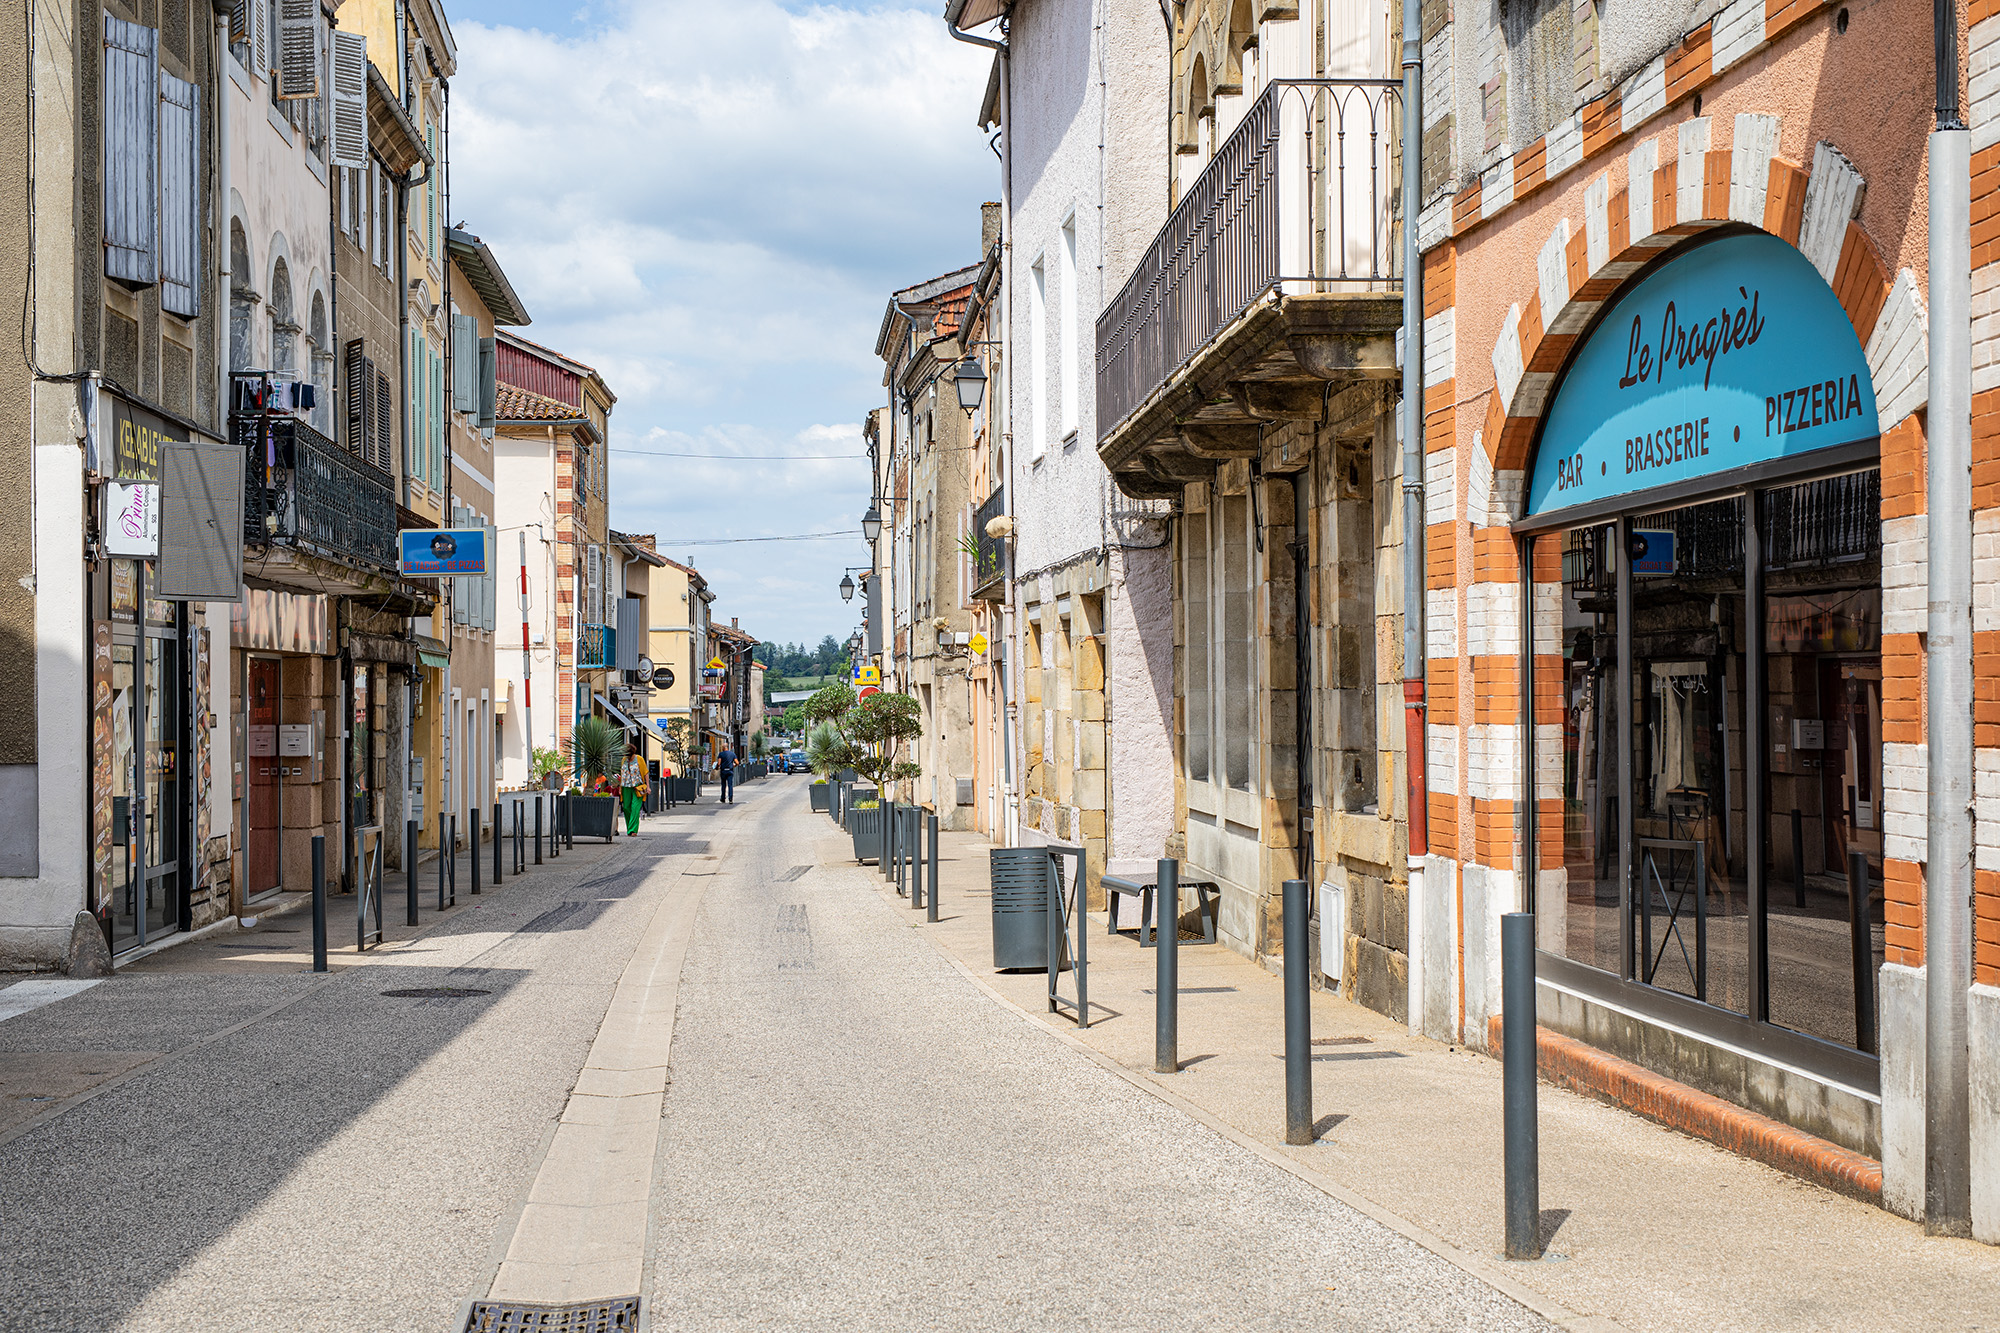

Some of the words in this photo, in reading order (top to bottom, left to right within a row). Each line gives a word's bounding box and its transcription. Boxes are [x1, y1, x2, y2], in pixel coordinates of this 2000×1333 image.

[1618, 313, 1654, 390] Le
[1656, 286, 1766, 391] Progrès
[1557, 452, 1584, 492] BAR
[1625, 416, 1710, 475] BRASSERIE
[1764, 373, 1863, 438] PIZZERIA
[120, 484, 143, 539] Prime
[403, 561, 413, 571] BE
[415, 560, 440, 571] TACOS
[447, 560, 457, 570] BE
[458, 560, 485, 570] PIZZAS
